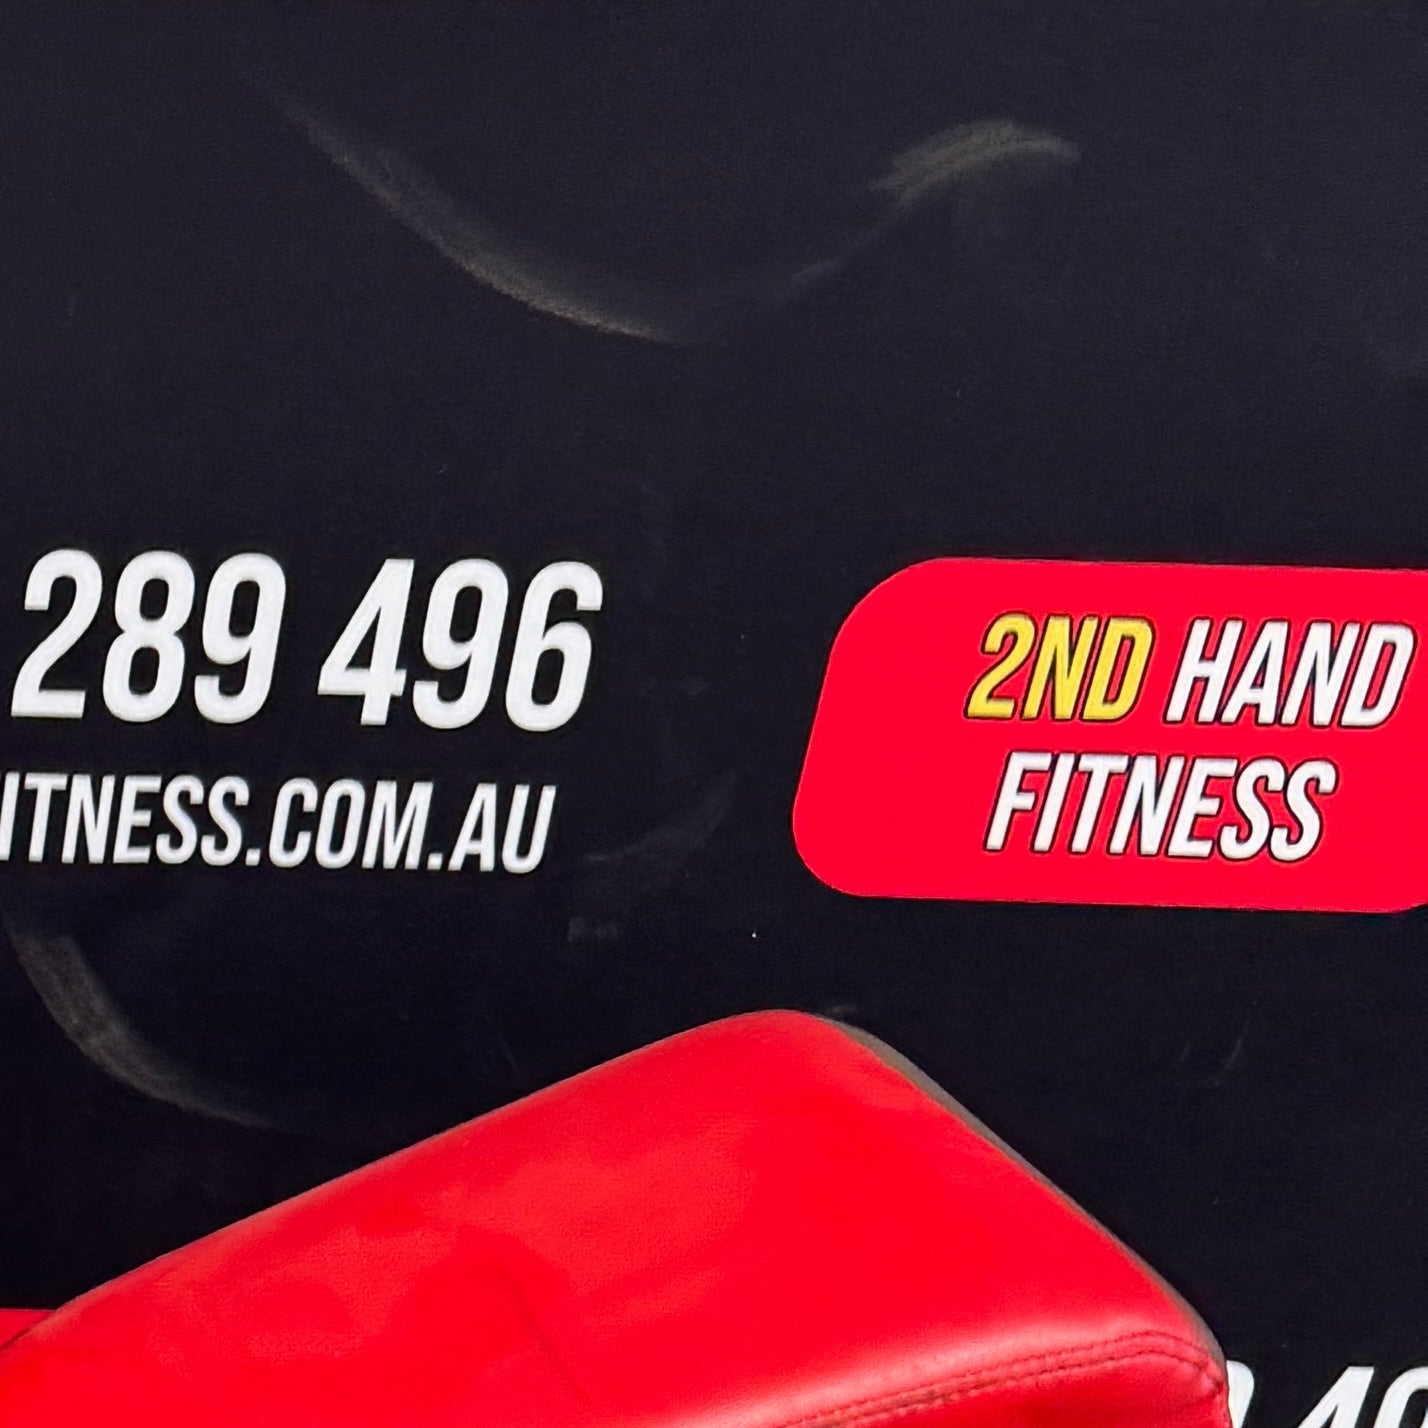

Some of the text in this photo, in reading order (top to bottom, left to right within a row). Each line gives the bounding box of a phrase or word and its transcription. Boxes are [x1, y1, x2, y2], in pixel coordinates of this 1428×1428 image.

[11, 549, 287, 724] 289
[317, 558, 603, 732] 496
[966, 613, 1415, 727] 2ND HAND
[985, 750, 1337, 862] FITNESS
